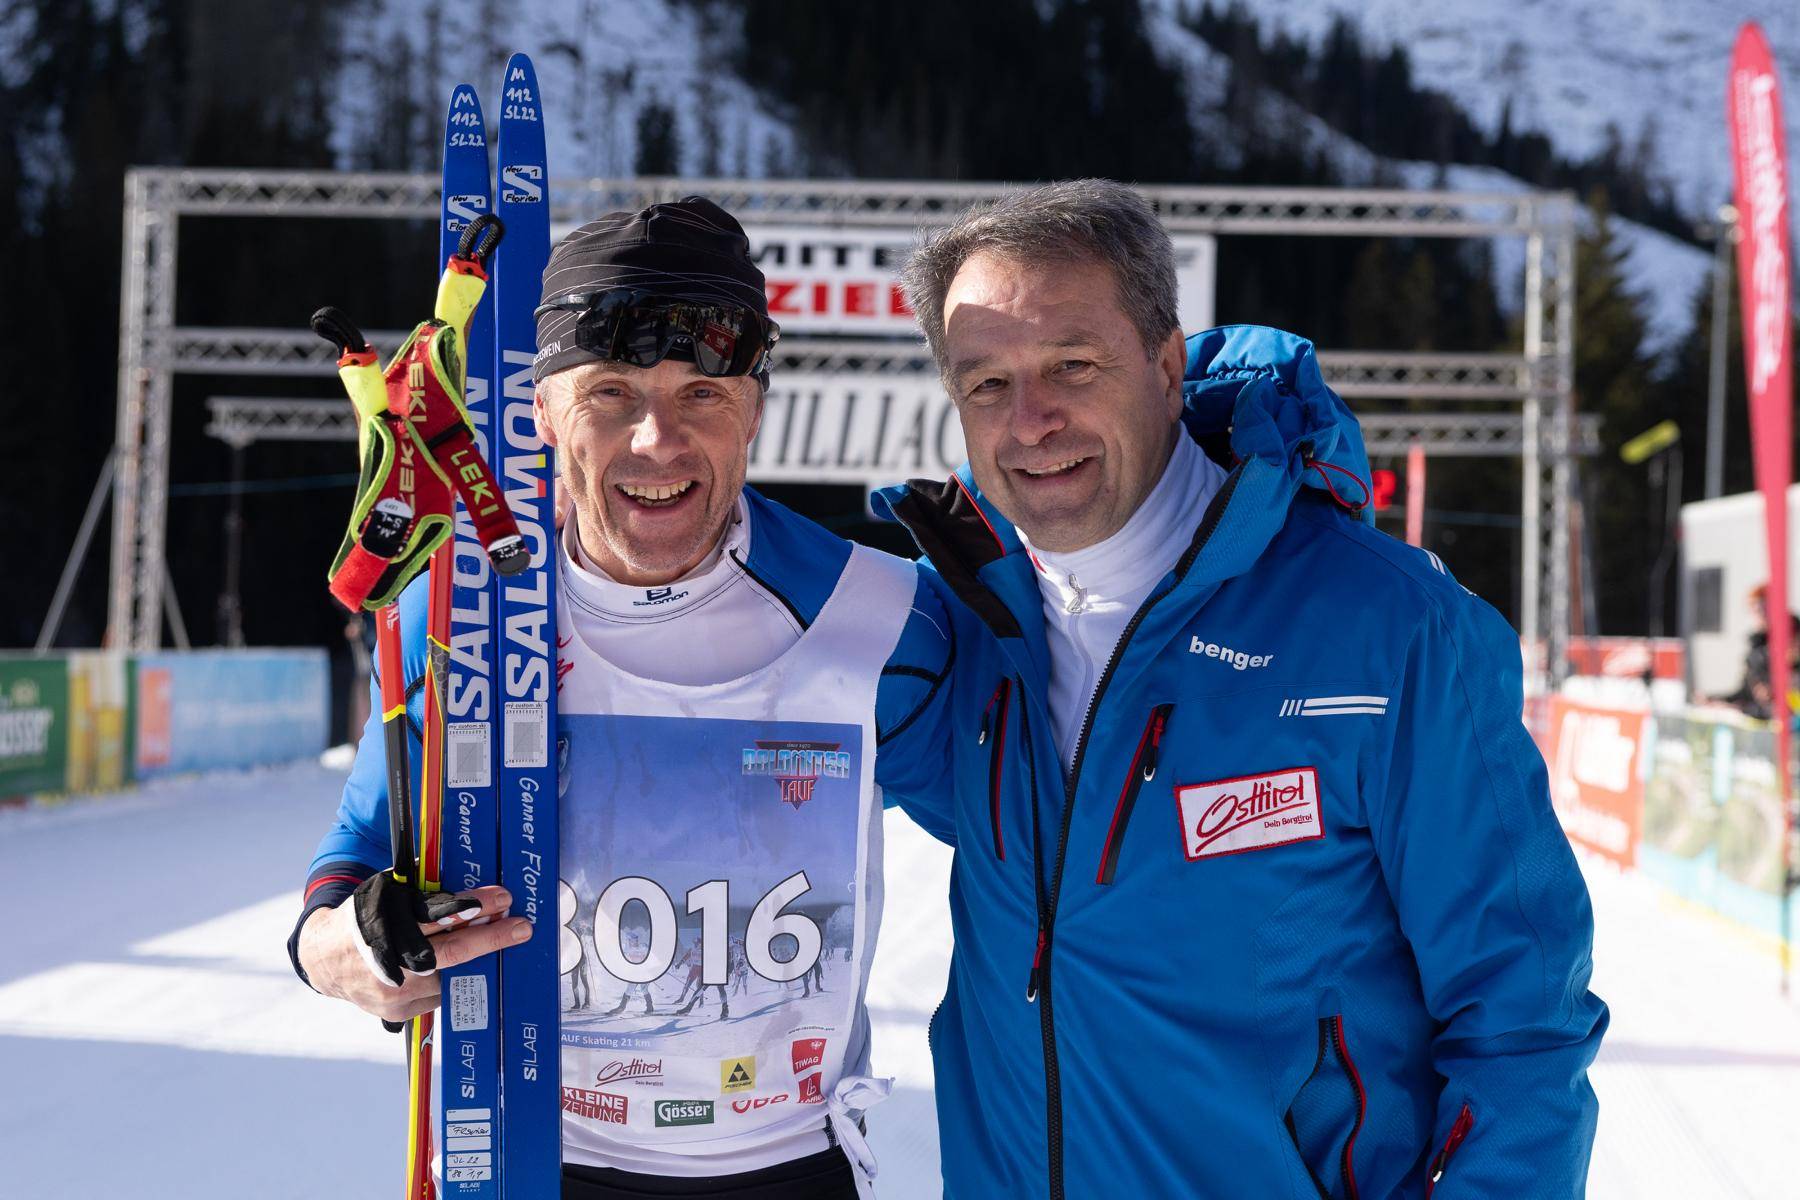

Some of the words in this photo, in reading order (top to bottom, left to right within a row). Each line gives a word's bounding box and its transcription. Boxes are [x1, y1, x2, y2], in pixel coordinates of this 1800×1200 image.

[510, 67, 526, 82] M
[454, 92, 475, 108] M
[506, 87, 533, 103] 112
[451, 111, 481, 127] 112
[503, 104, 538, 122] SL22
[448, 132, 485, 147] SL22
[505, 193, 539, 203] Florian
[451, 450, 500, 517] LEKI
[1188, 635, 1274, 671] benger
[781, 780, 815, 802] LAUF
[519, 776, 540, 844] Ganner
[1196, 774, 1305, 838] Osttirol
[457, 791, 477, 854] Ganner
[1264, 820, 1281, 829] Dein
[520, 850, 543, 926] Florian
[582, 1036, 619, 1048] Skating
[621, 1038, 633, 1047] 21
[635, 1038, 651, 1047] km
[597, 1058, 662, 1081] Osttirol
[795, 1056, 819, 1070] TIWAG
[563, 1087, 625, 1110] KLEINE
[563, 1099, 623, 1124] ZEITUNG
[657, 1101, 711, 1122] Gösser
